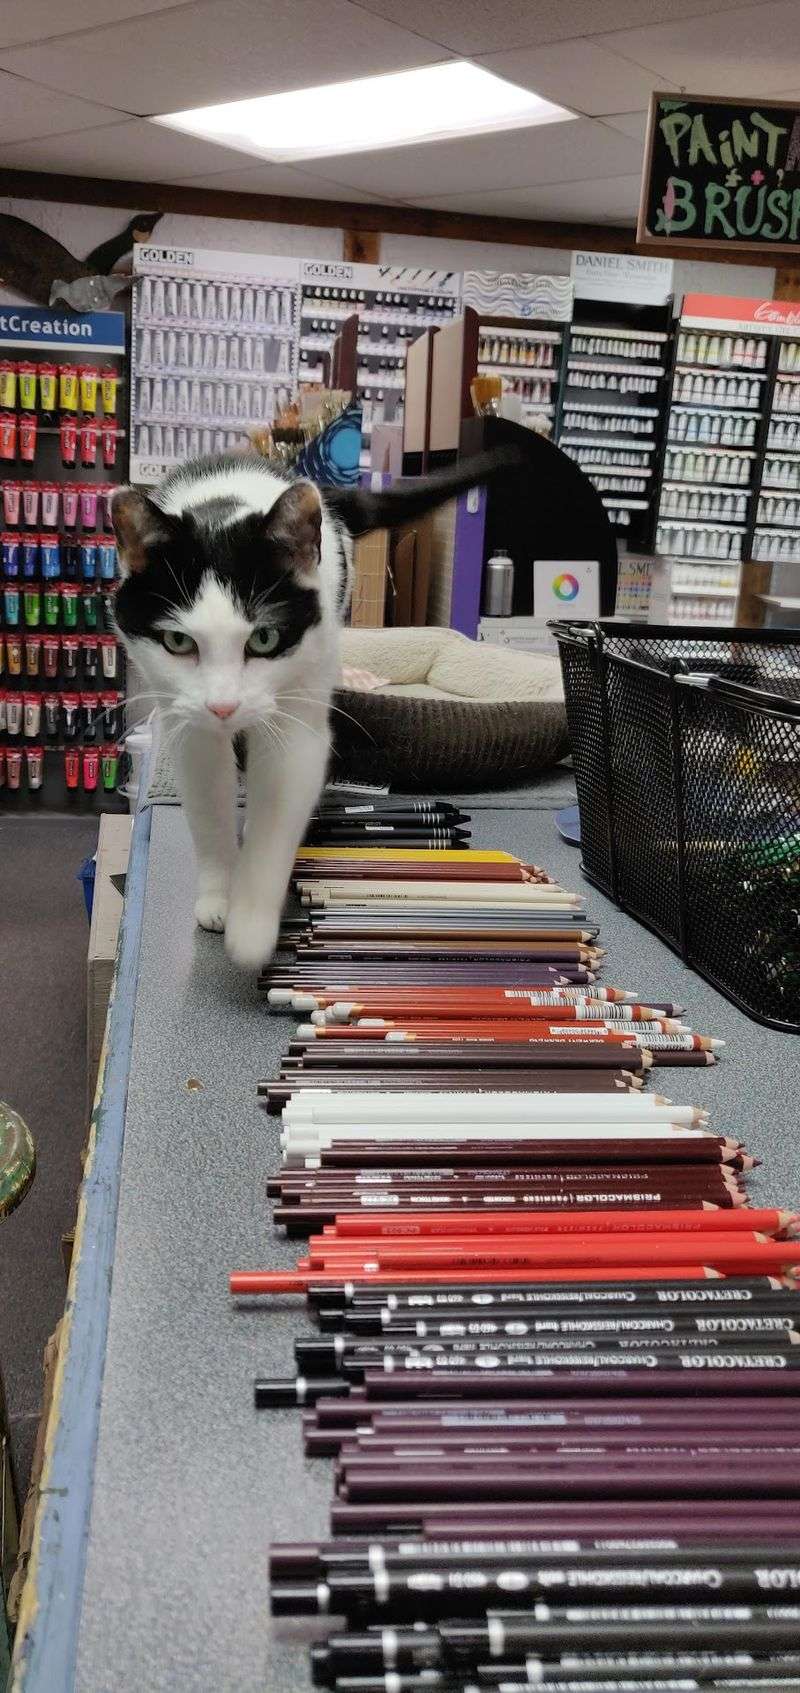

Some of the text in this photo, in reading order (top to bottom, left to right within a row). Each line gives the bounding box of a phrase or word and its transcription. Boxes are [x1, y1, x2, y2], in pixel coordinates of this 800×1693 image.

[140, 248, 193, 265] GOLDEN
[304, 262, 353, 279] GOLDEN
[575, 254, 671, 274] DANIEL SMITH
[575, 1193, 661, 1203] PRISMACOLOR
[612, 1223, 701, 1232] PRISMACOLOR
[656, 1289, 753, 1301] CRETACOLOR
[695, 1317, 795, 1332] CRETACOLOR
[679, 1354, 787, 1368] CRETACOLOR
